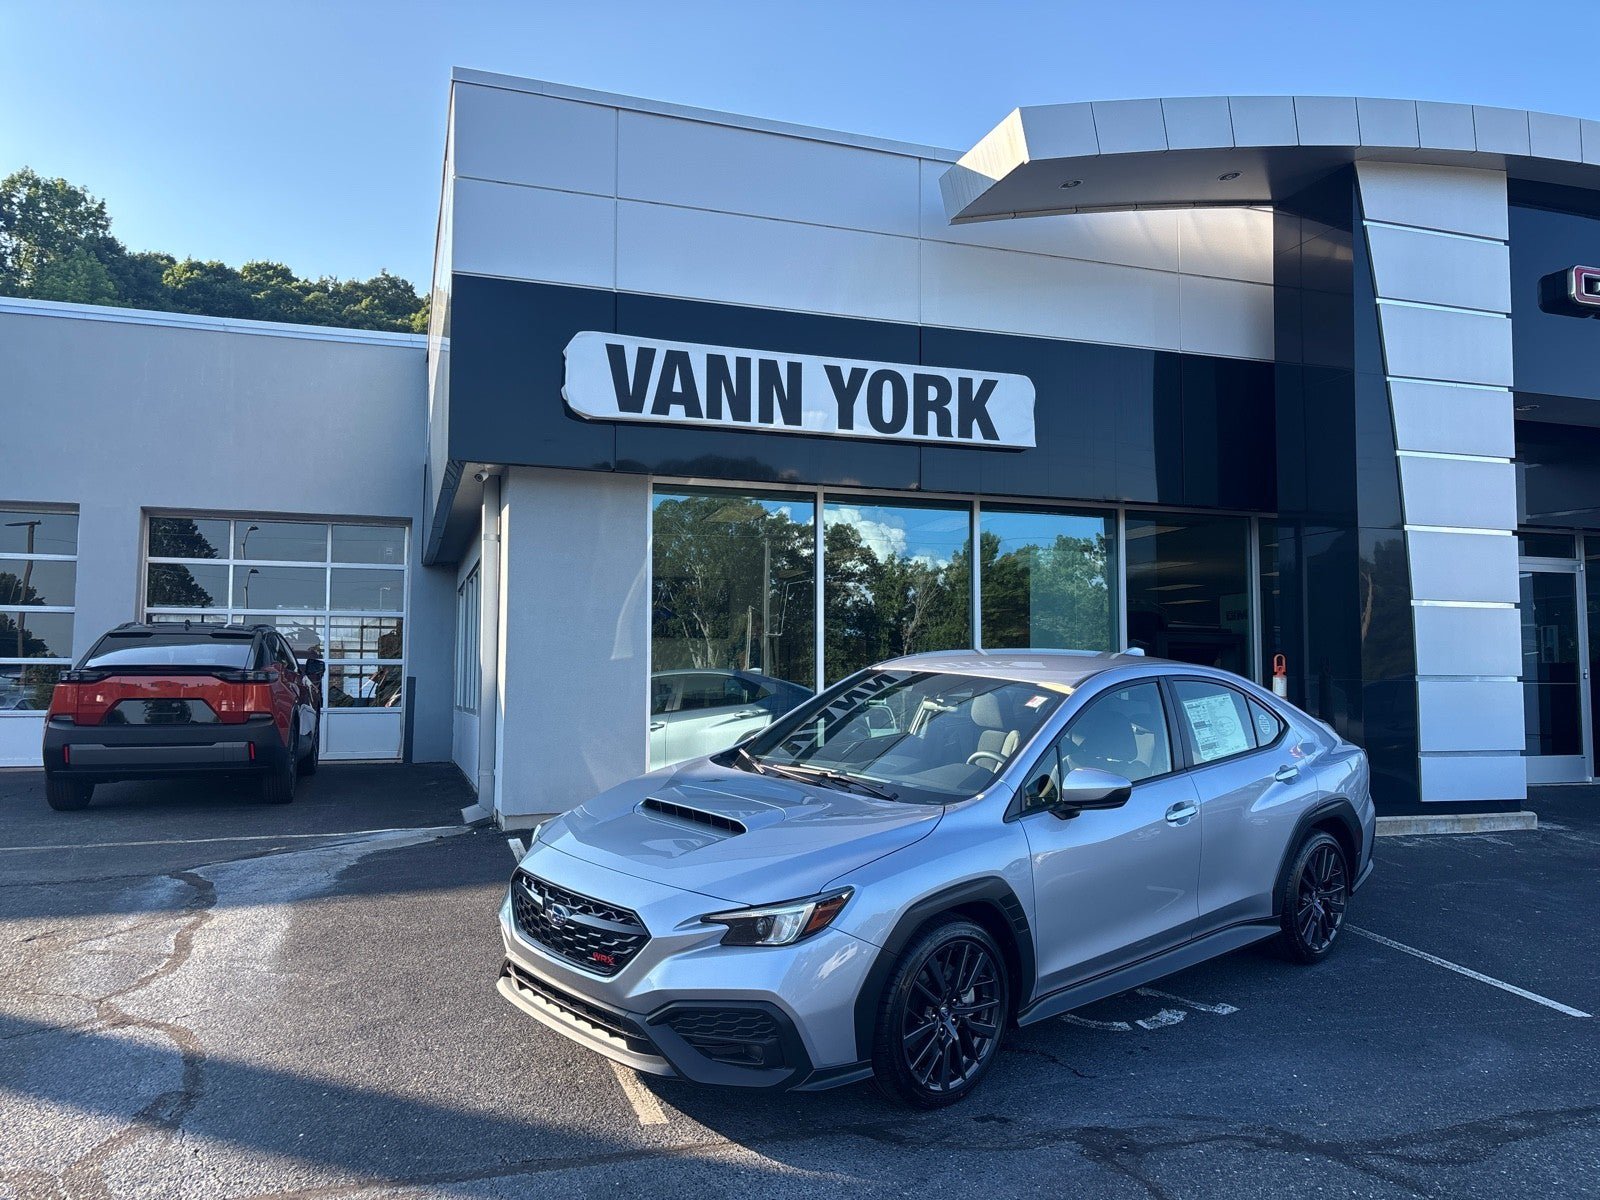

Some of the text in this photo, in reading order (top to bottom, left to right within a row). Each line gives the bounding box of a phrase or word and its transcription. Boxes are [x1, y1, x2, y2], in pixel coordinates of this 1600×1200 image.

[605, 343, 1000, 441] VANN YORK
[592, 952, 614, 965] WRX
